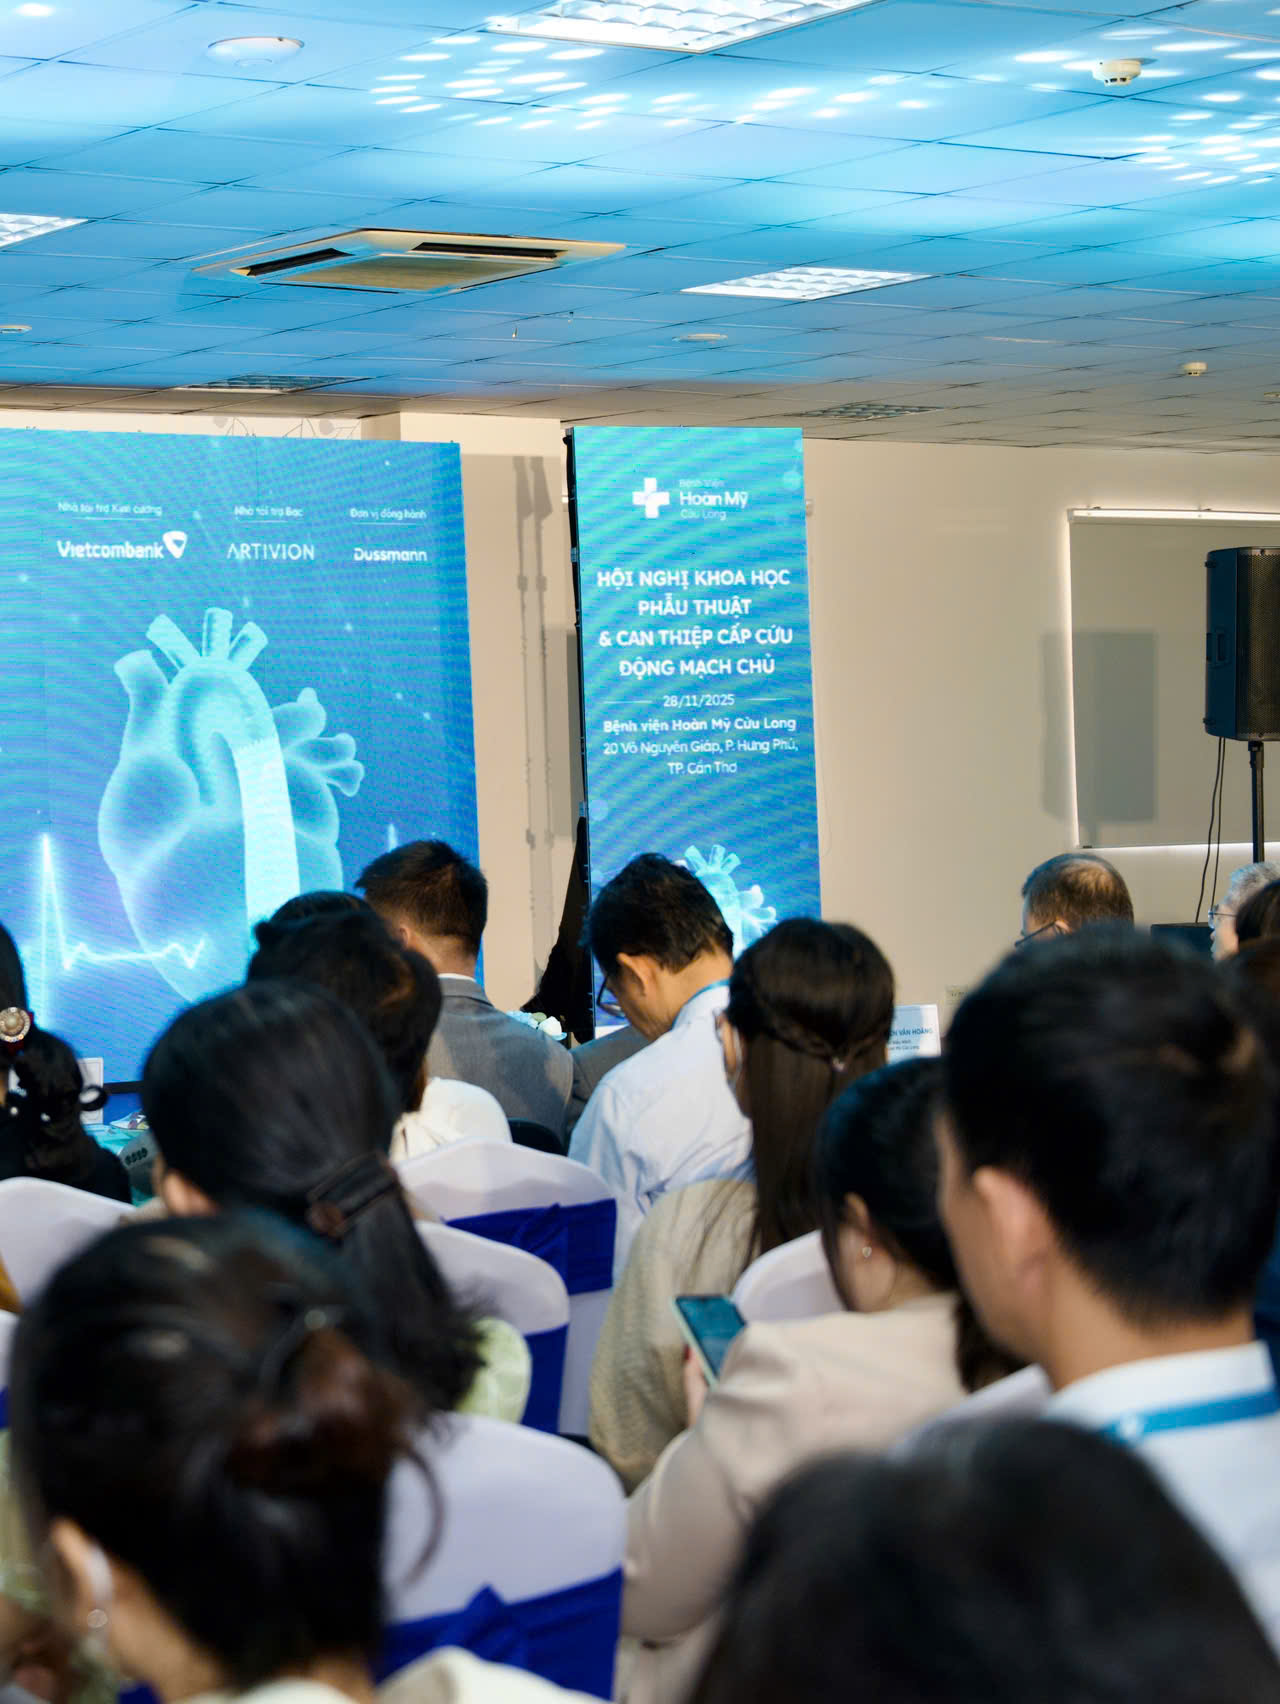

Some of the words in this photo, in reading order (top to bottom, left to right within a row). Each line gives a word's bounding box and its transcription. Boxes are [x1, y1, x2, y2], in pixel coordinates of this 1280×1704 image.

[679, 490, 722, 506] Hoàn
[725, 490, 748, 509] Mỹ
[57, 540, 164, 559] Vietcombank
[226, 543, 315, 561] ARTIVION
[354, 547, 428, 562] Dussmann
[597, 567, 633, 590] HỘI
[639, 570, 689, 590] NGHỊ
[695, 570, 746, 586] KHOA
[751, 569, 790, 589] HỌC
[638, 592, 688, 616] PHẪU
[693, 595, 752, 619] THUẬT
[599, 630, 612, 647] &
[616, 630, 654, 646] CAN
[658, 625, 713, 649] THIỆP
[717, 622, 752, 645] CẤP
[755, 624, 793, 645] CỨU
[619, 656, 675, 680] ĐỘNG
[680, 658, 732, 679] MẠCH
[736, 652, 775, 674] CHỦ
[663, 693, 735, 709] 28/11/2025
[603, 719, 638, 735] Bệnh
[640, 719, 669, 735] viện
[672, 718, 708, 732] Hoàn
[711, 717, 731, 732] Mỹ
[763, 717, 796, 732] Long
[603, 742, 618, 755] 20
[640, 741, 689, 756] Nguyên
